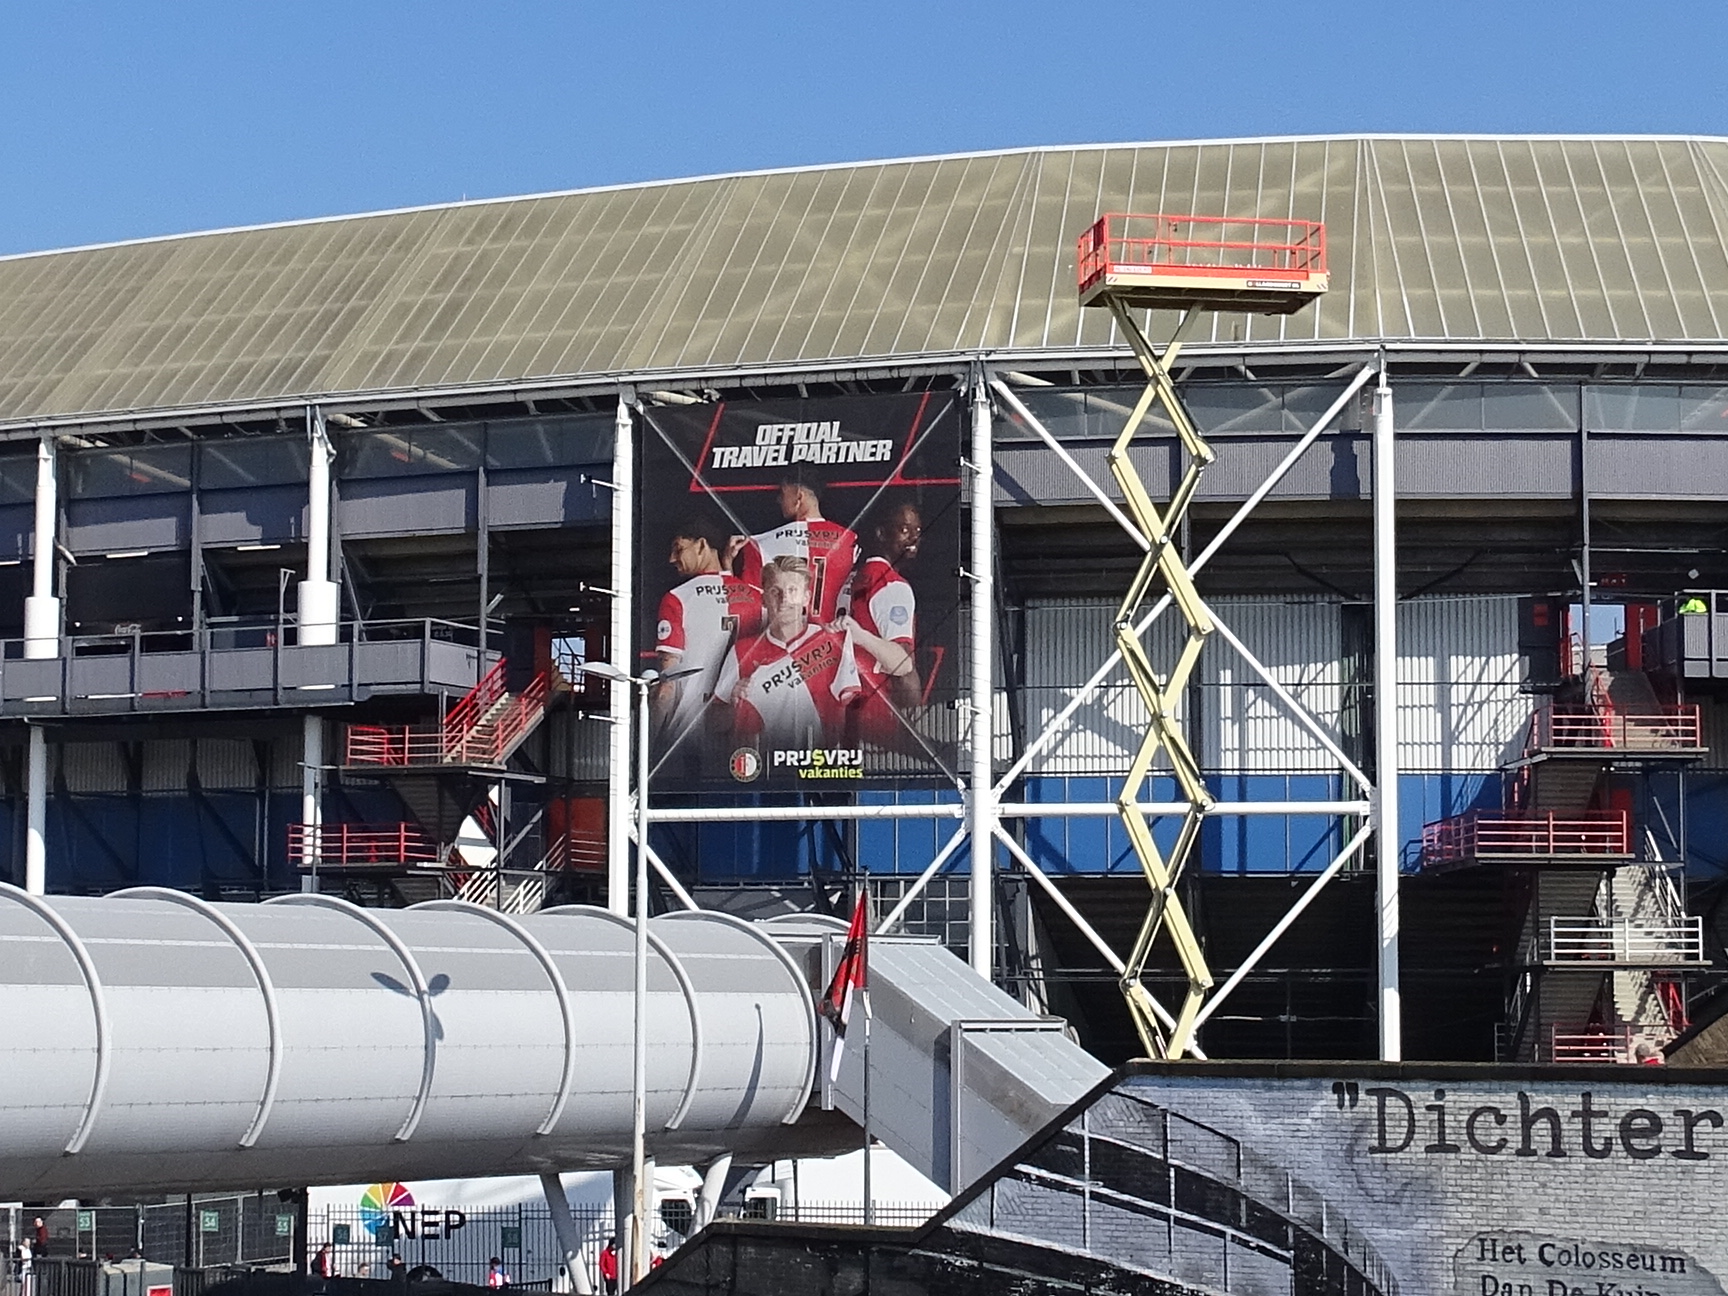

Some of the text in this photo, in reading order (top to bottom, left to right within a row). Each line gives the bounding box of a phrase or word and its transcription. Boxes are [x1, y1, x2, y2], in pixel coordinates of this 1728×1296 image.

[755, 421, 842, 445] OFFICIAL
[712, 440, 892, 469] TRAVEL PARTNER
[774, 749, 863, 767] PRIJSVRIJ
[798, 767, 863, 779] vakanties
[1332, 1081, 1724, 1160] "Dichter
[203, 1216, 217, 1228] 54
[394, 1210, 466, 1240] NEP
[1476, 1238, 1686, 1274] Het Colosseum
